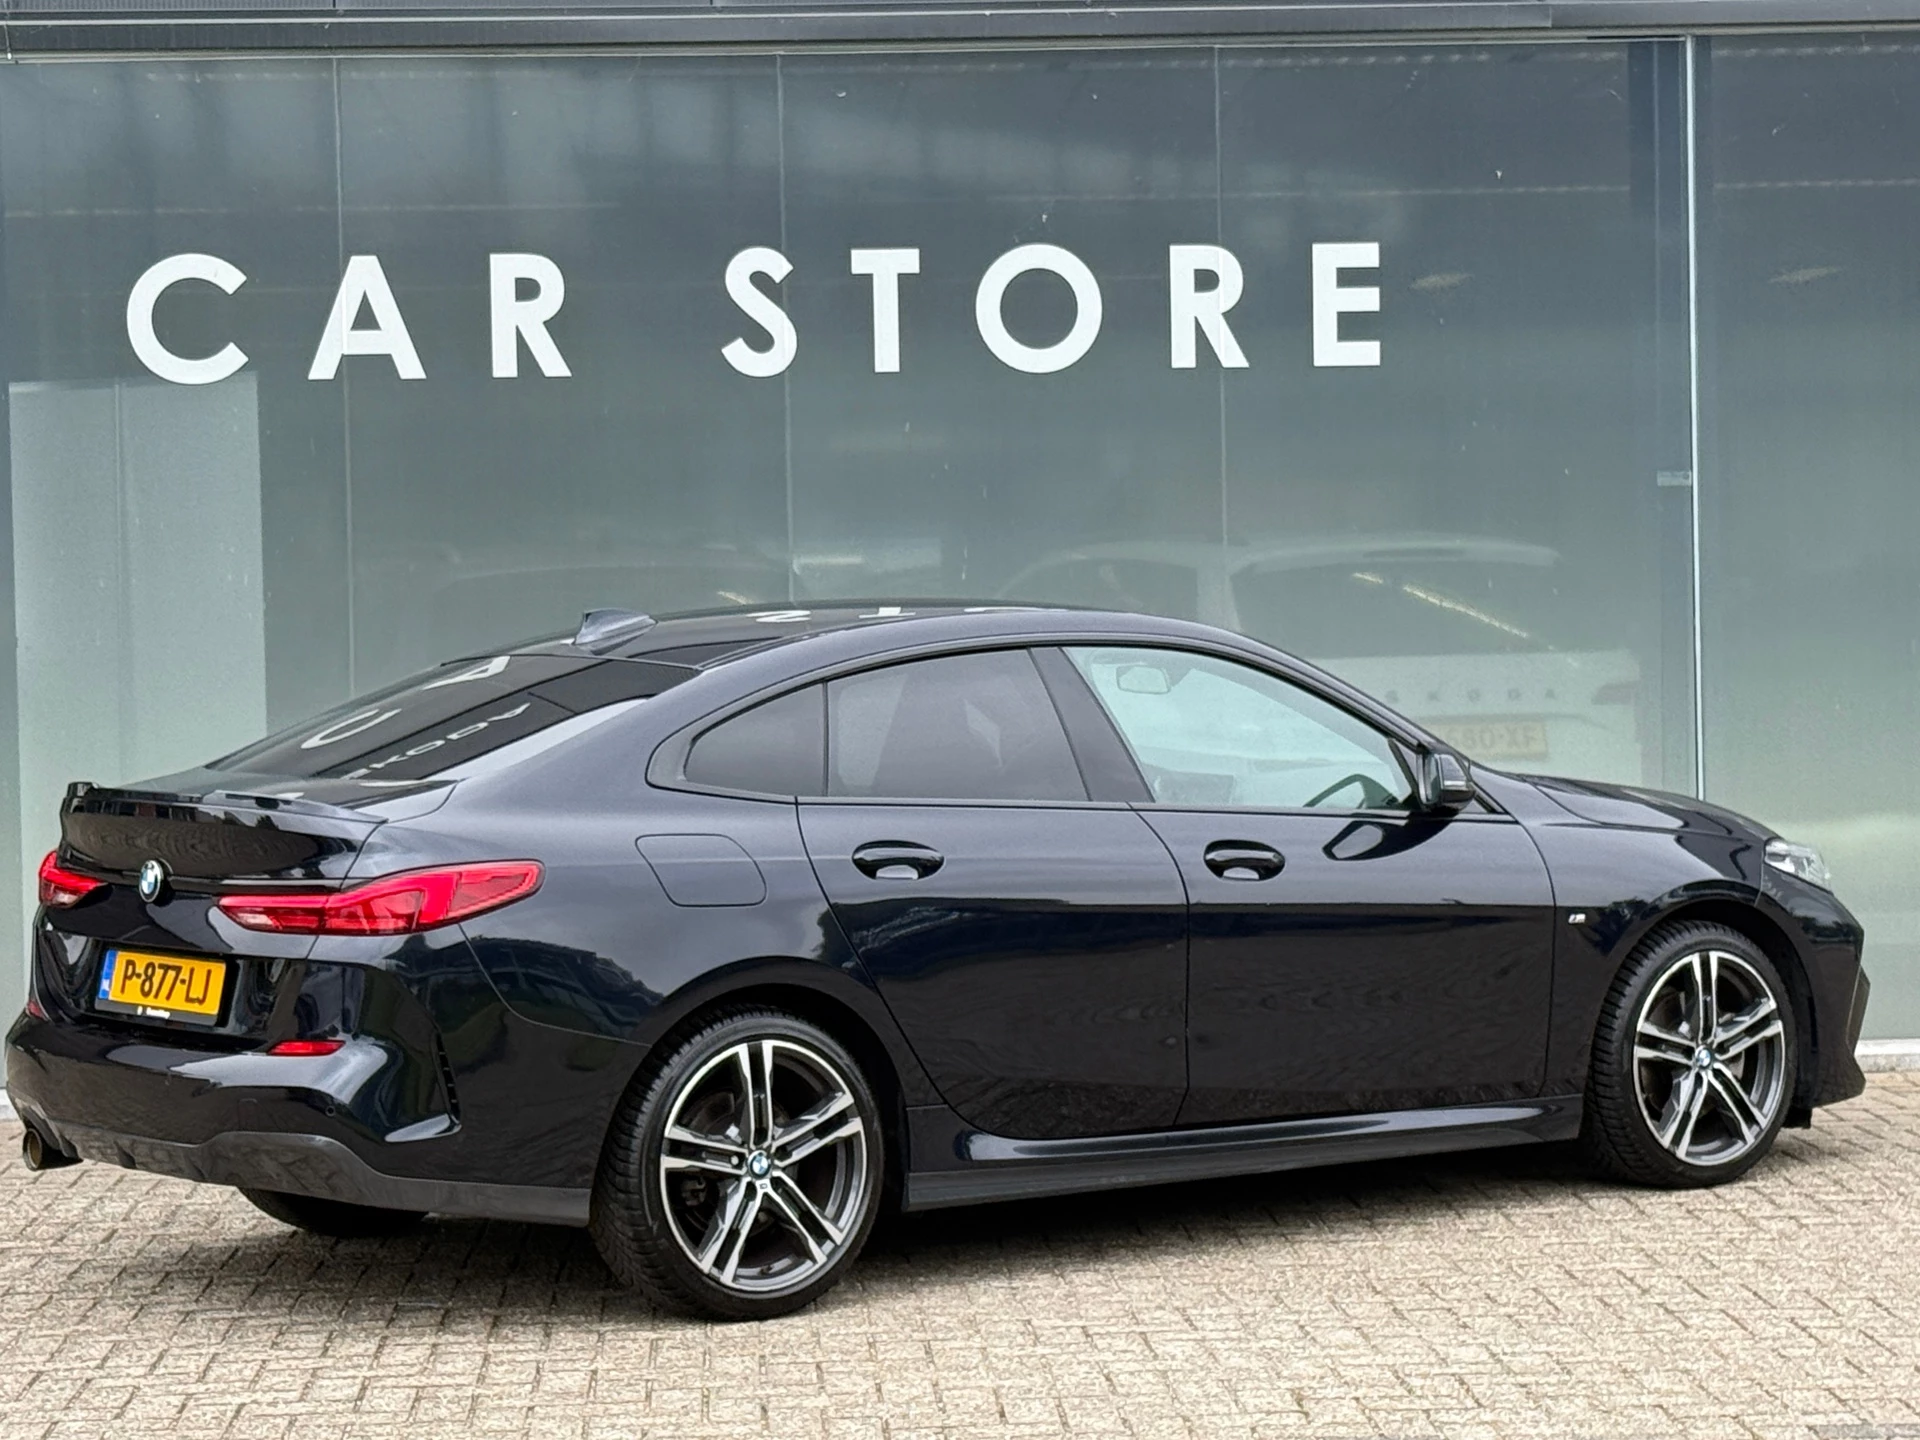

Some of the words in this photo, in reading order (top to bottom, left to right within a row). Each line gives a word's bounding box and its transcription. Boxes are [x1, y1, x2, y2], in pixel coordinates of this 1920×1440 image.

[127, 252, 572, 385] CAR
[721, 242, 1381, 377] STORE
[120, 959, 212, 1006] P-877-LJ
